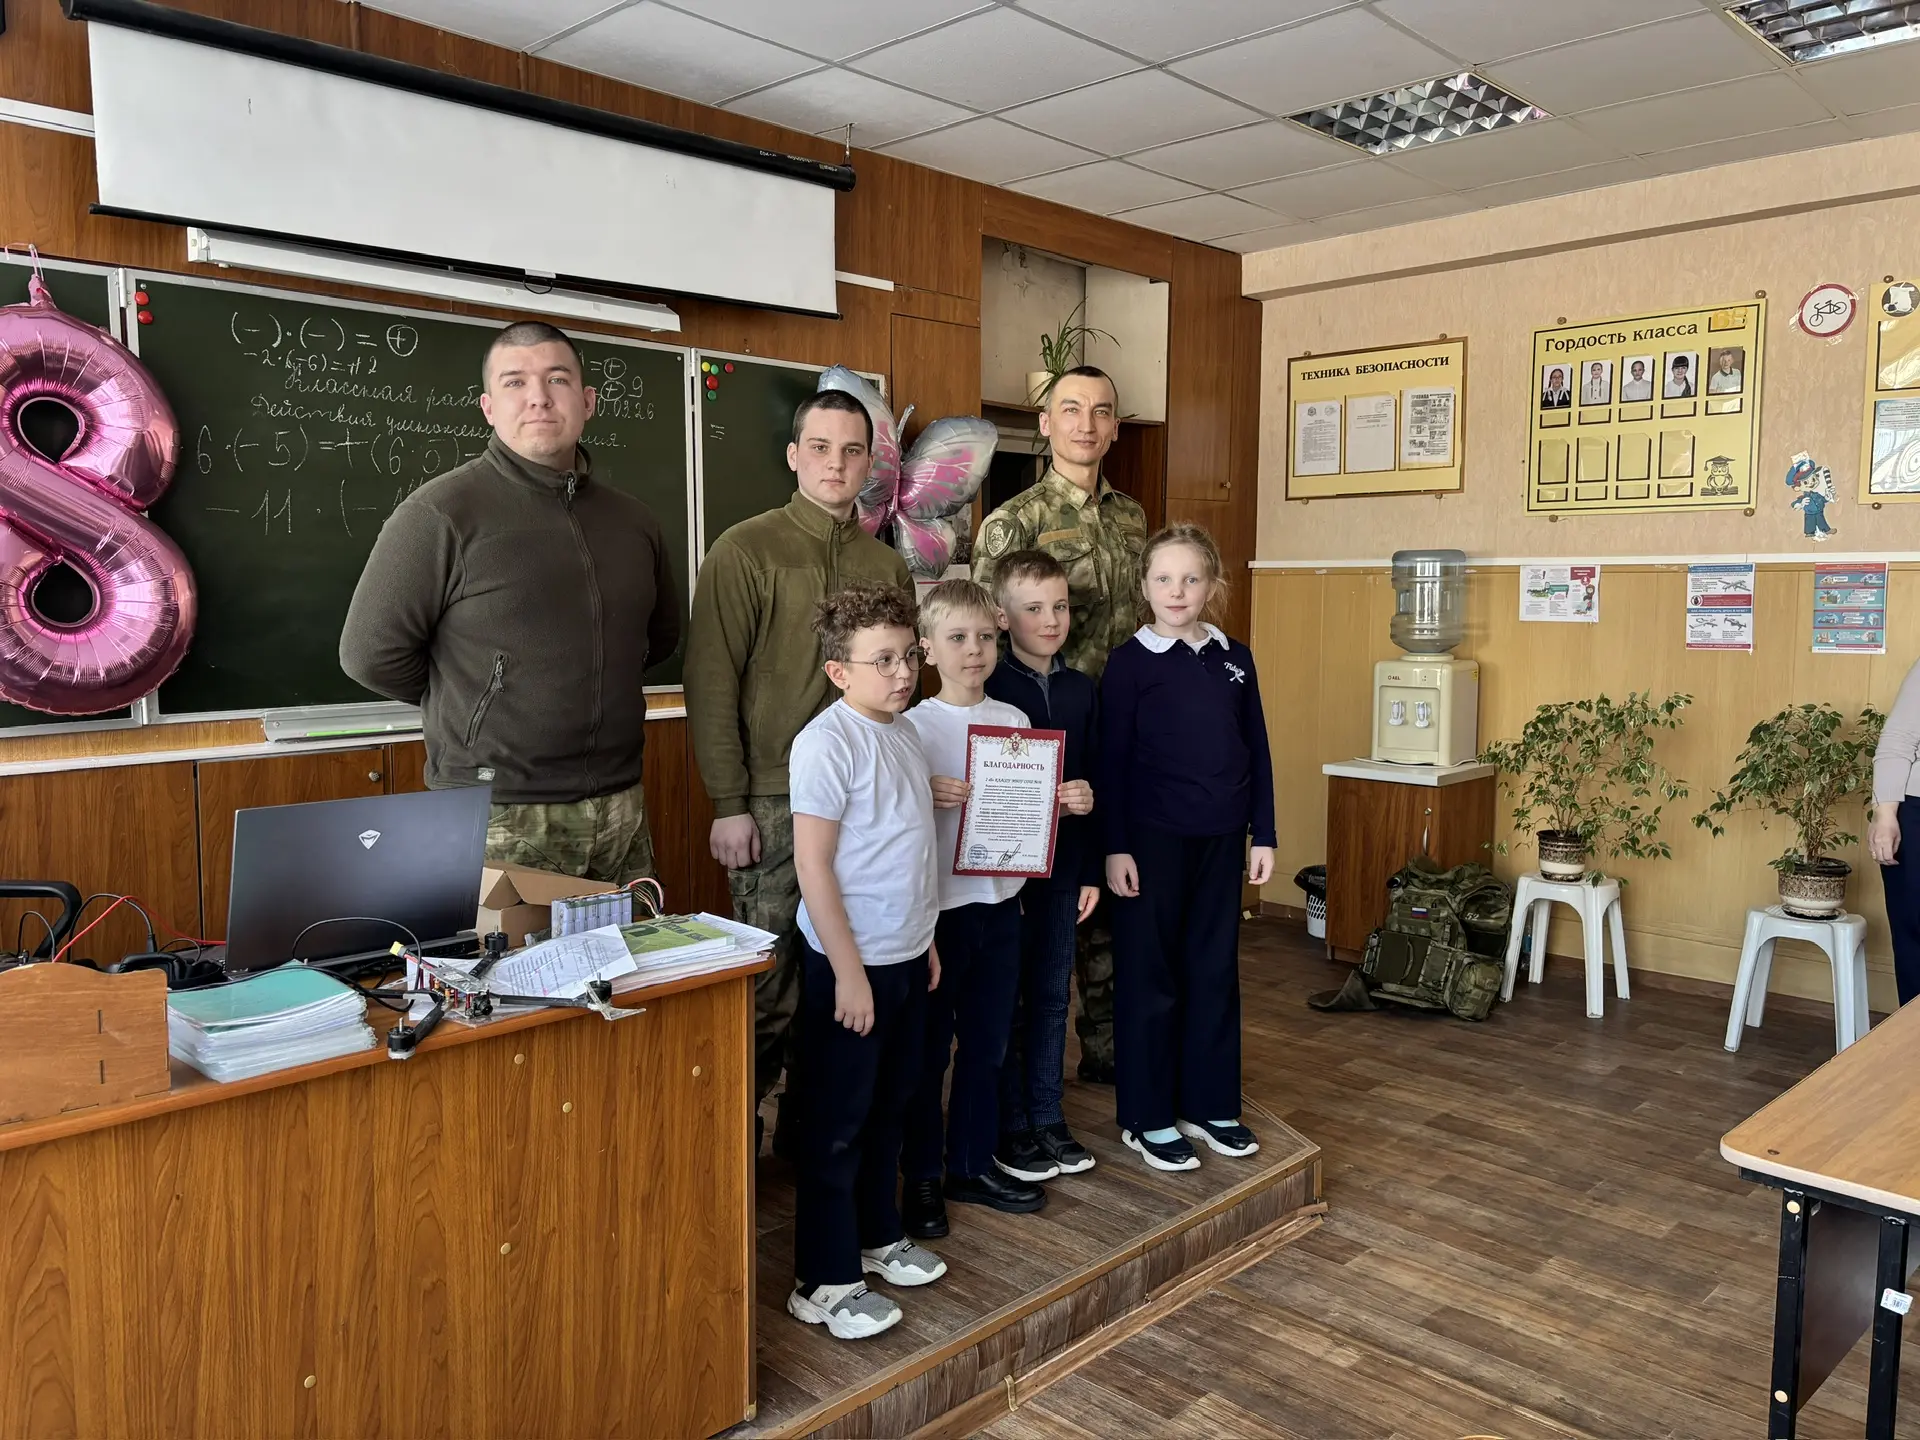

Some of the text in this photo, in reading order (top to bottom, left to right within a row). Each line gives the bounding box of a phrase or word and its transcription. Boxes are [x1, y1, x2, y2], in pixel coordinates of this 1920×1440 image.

[1544, 323, 1698, 353] Гордость класса
[1301, 356, 1450, 381] ТЕХНИКА БЕЗОПАСНОСТИ
[386, 414, 492, 440] умножени
[983, 760, 1045, 771] БЛАГОДАРНОСТЬ
